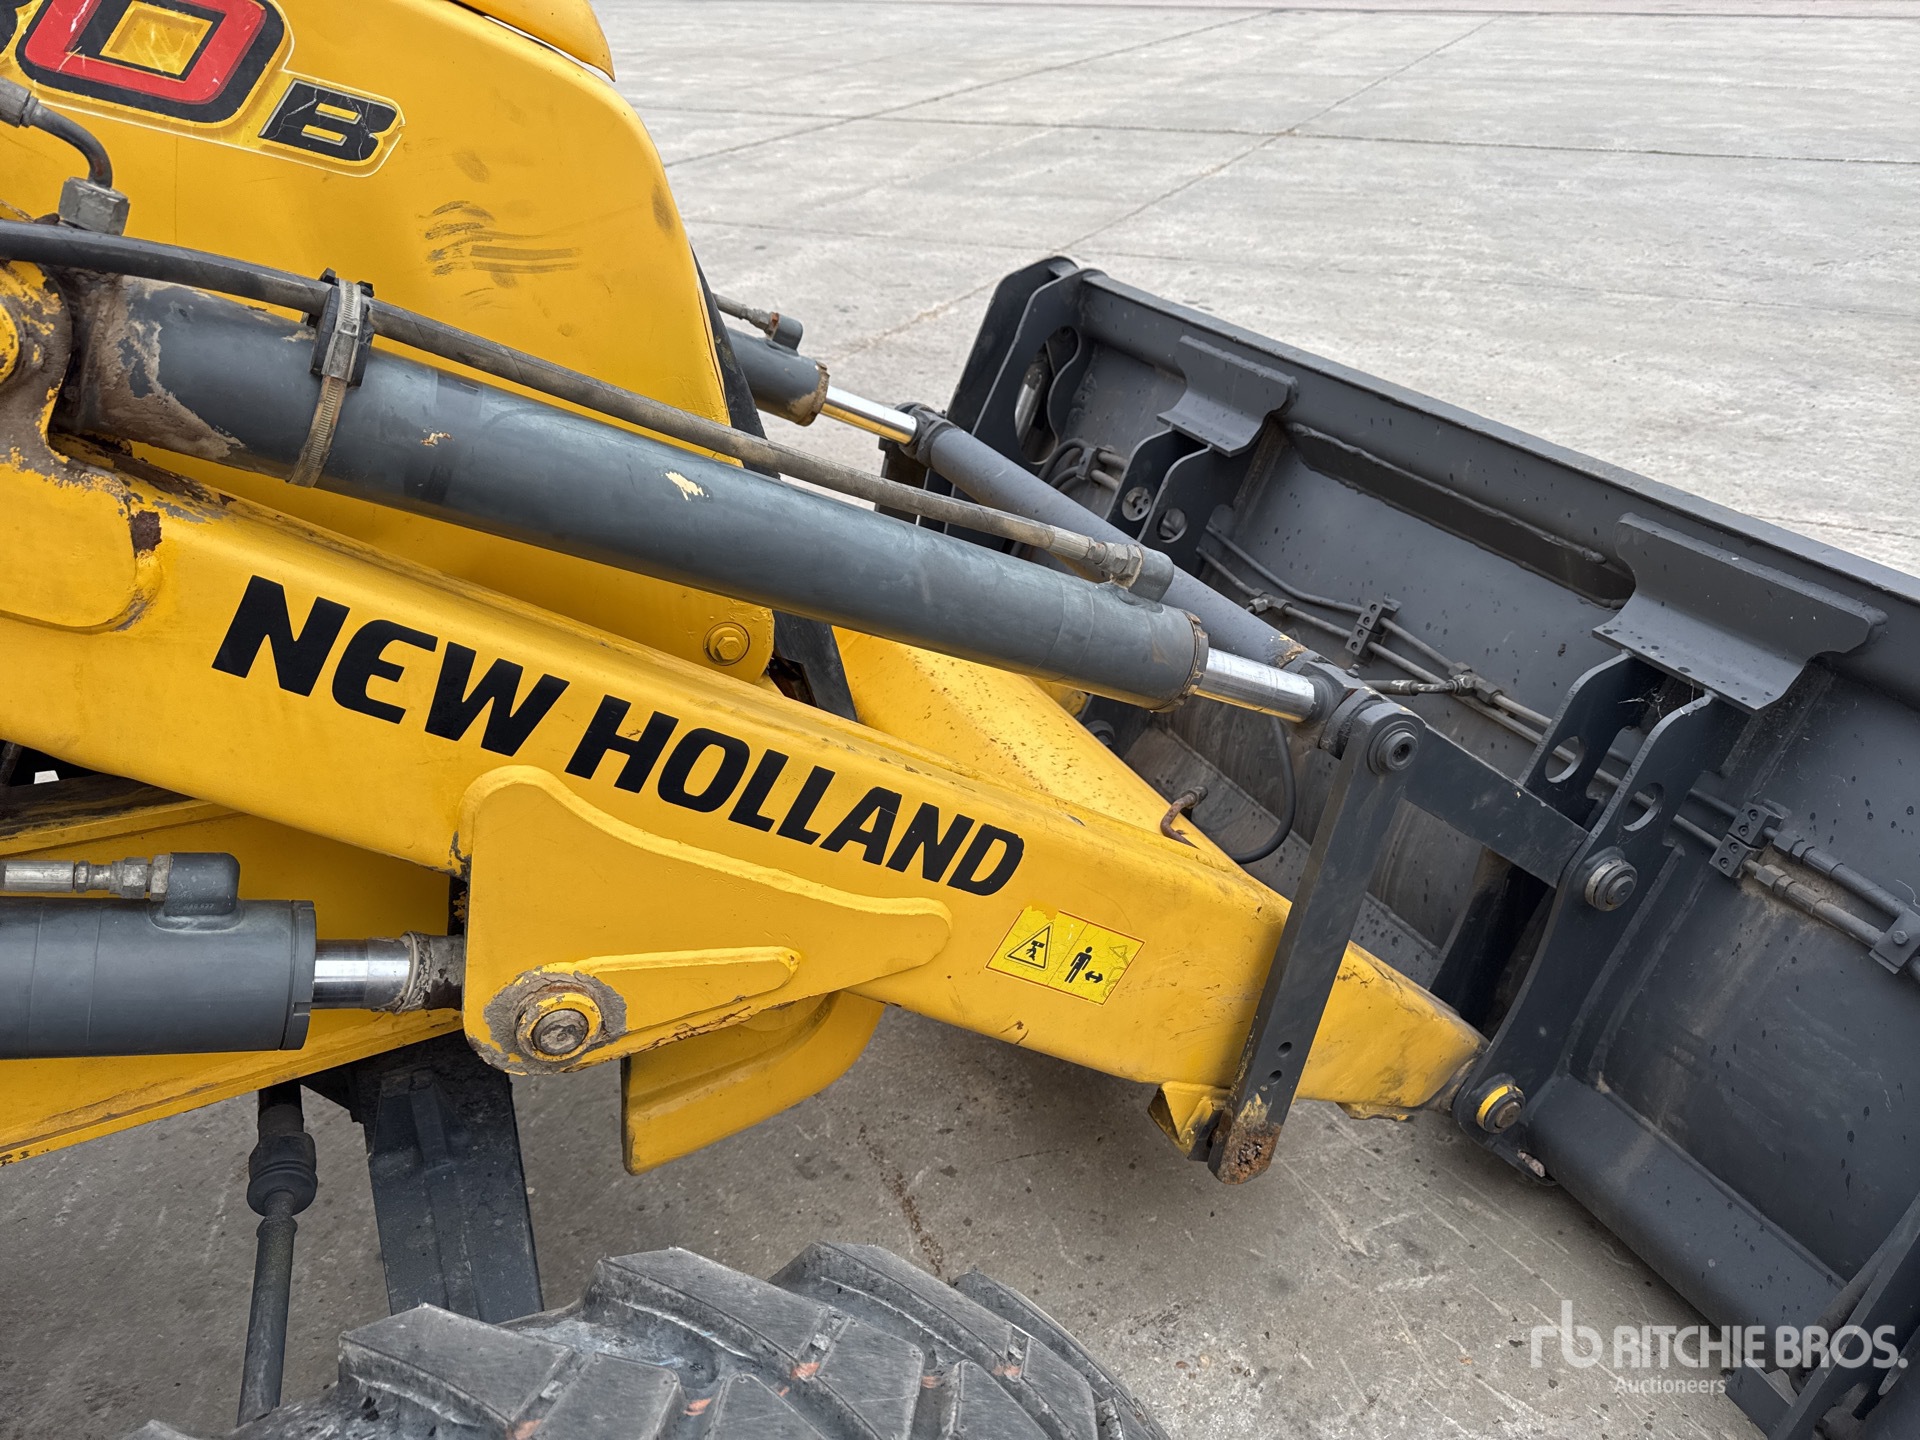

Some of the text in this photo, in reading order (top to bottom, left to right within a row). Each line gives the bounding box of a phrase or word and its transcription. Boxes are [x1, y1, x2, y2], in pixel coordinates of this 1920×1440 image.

[0, 0, 400, 162] 0 B
[211, 574, 1025, 896] NEW HOLLAND
